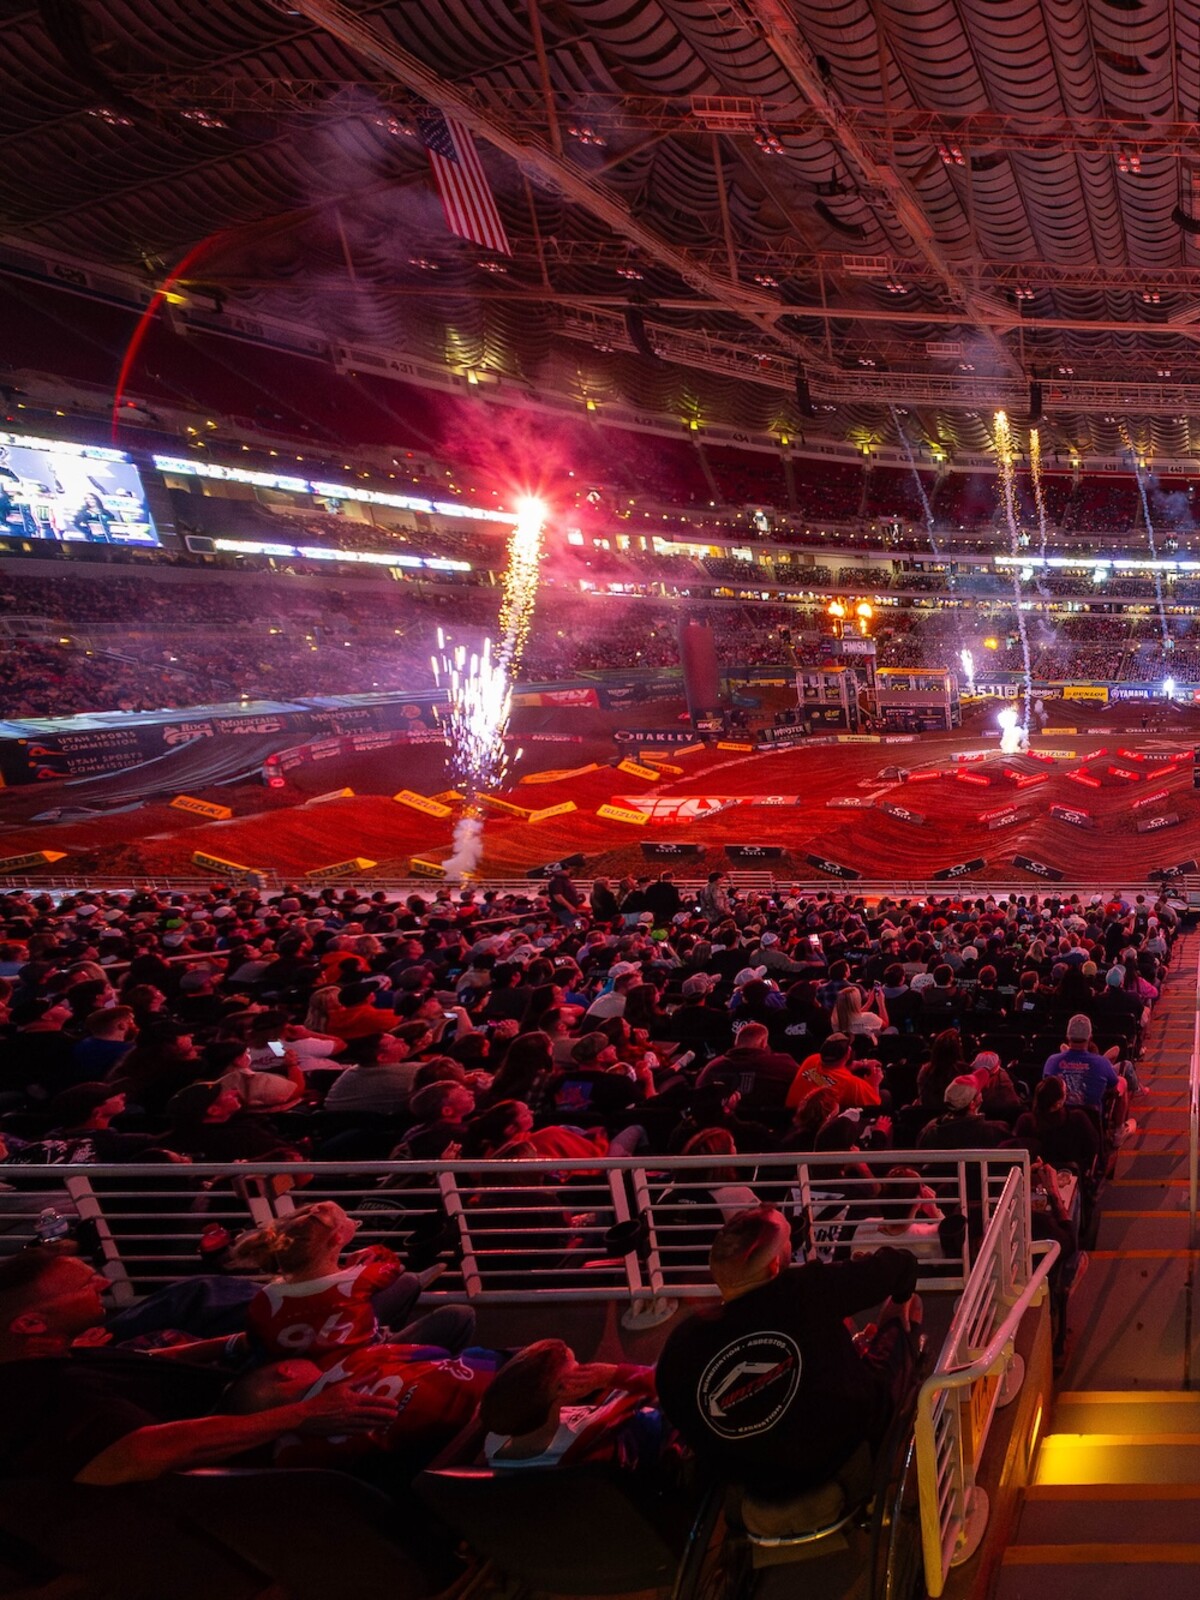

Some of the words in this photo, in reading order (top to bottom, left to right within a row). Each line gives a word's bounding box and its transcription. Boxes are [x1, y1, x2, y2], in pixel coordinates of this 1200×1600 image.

[390, 359, 414, 375] 431
[842, 641, 868, 653] FINISH
[1119, 689, 1149, 698] YAMAHA
[57, 735, 90, 745] UTAH
[94, 730, 137, 742] SPORTS
[636, 732, 694, 742] OAKLEY
[62, 738, 138, 751] COMMISSION
[67, 756, 98, 768] UTAH
[103, 751, 143, 763] SPORTS
[69, 759, 145, 774] COMMISSION
[1114, 770, 1131, 779] FLY
[1140, 790, 1169, 805] HONDA
[602, 807, 645, 821] SUZUKI
[276, 1311, 353, 1349] 96
[747, 1337, 788, 1349] ASBESTOS
